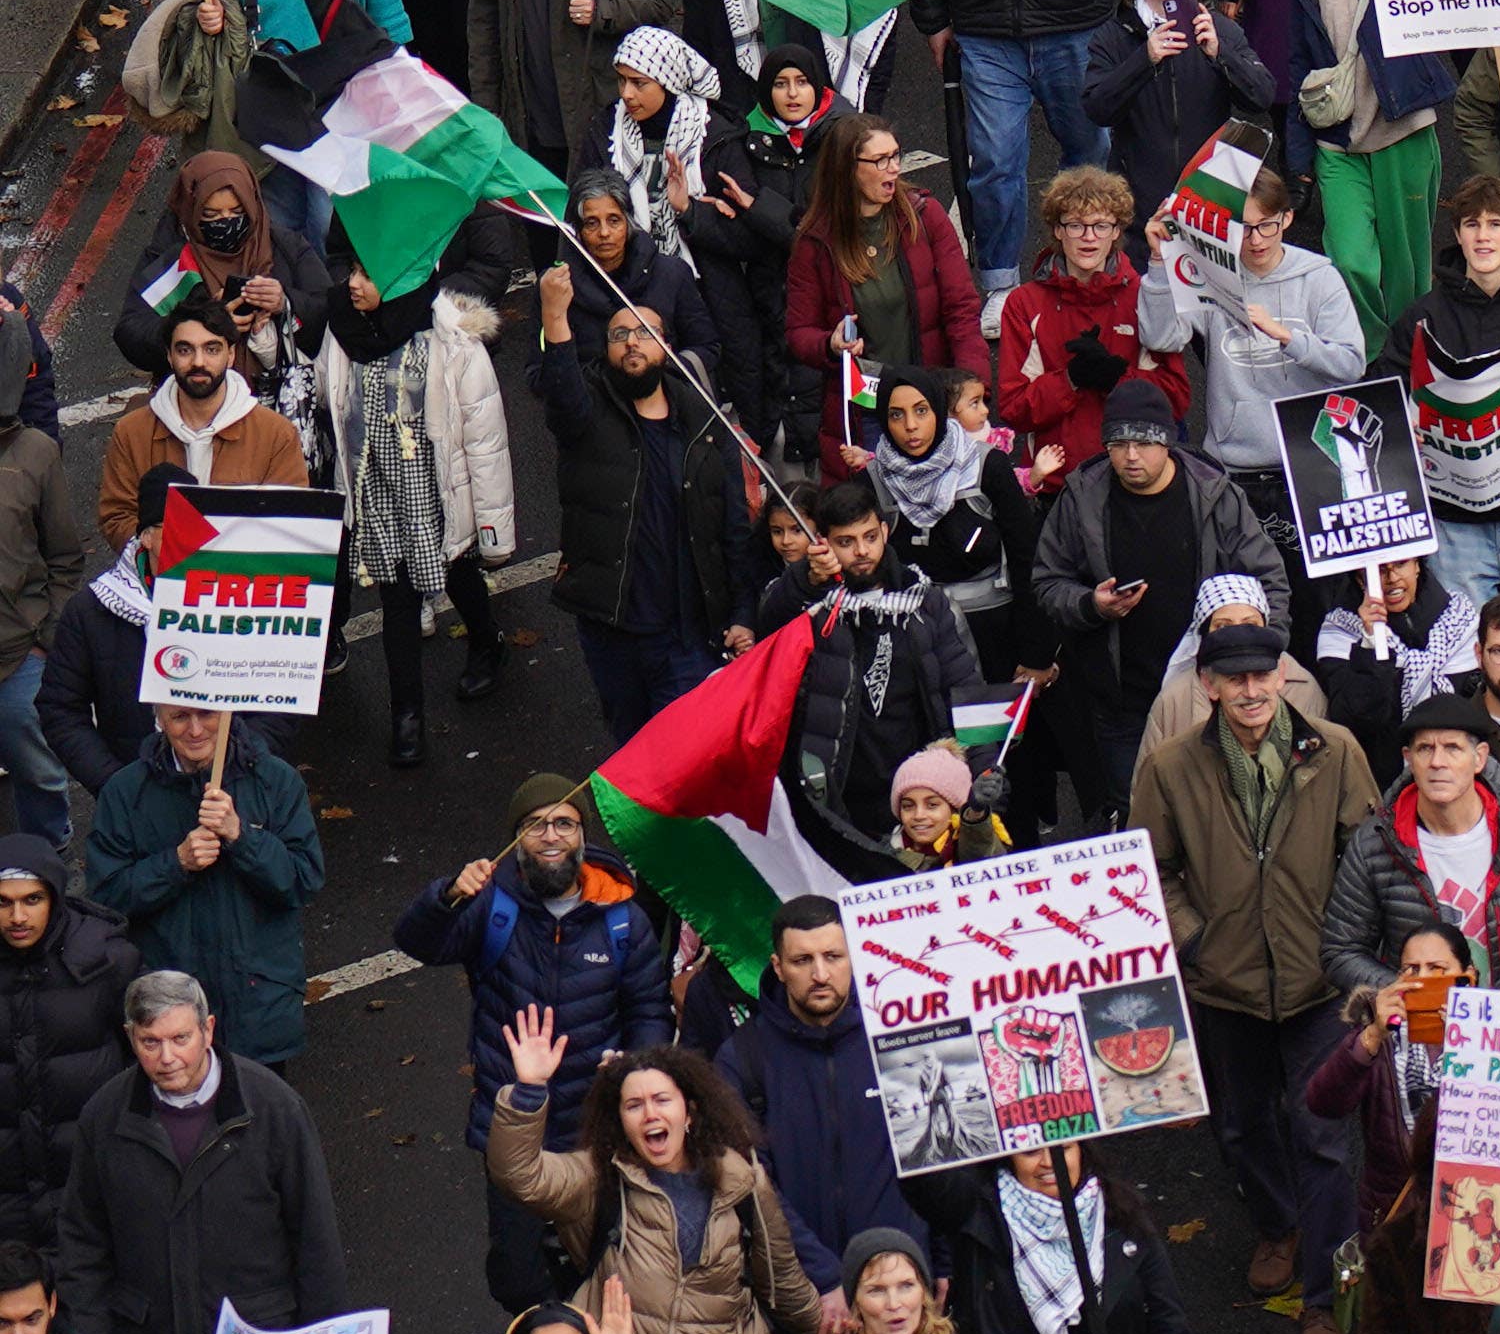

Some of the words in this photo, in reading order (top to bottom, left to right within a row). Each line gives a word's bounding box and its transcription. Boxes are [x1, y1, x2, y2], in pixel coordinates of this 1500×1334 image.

[1320, 493, 1410, 529] FREE
[1310, 512, 1429, 558] PALESTINE
[184, 570, 309, 607] FREE
[158, 610, 322, 638] PALESTINE
[169, 688, 297, 705] WWW.PFBUK.COM
[844, 891, 876, 906] REAL
[881, 881, 935, 901] EYES
[950, 859, 1039, 888] REALISE
[1053, 848, 1097, 865] REAL
[881, 991, 948, 1027] OUR
[972, 943, 1170, 1011] HUMANITY
[1448, 995, 1470, 1020] Is
[1477, 997, 1494, 1022] it
[1445, 1023, 1475, 1048] Or
[998, 1089, 1095, 1127] FREEDOM
